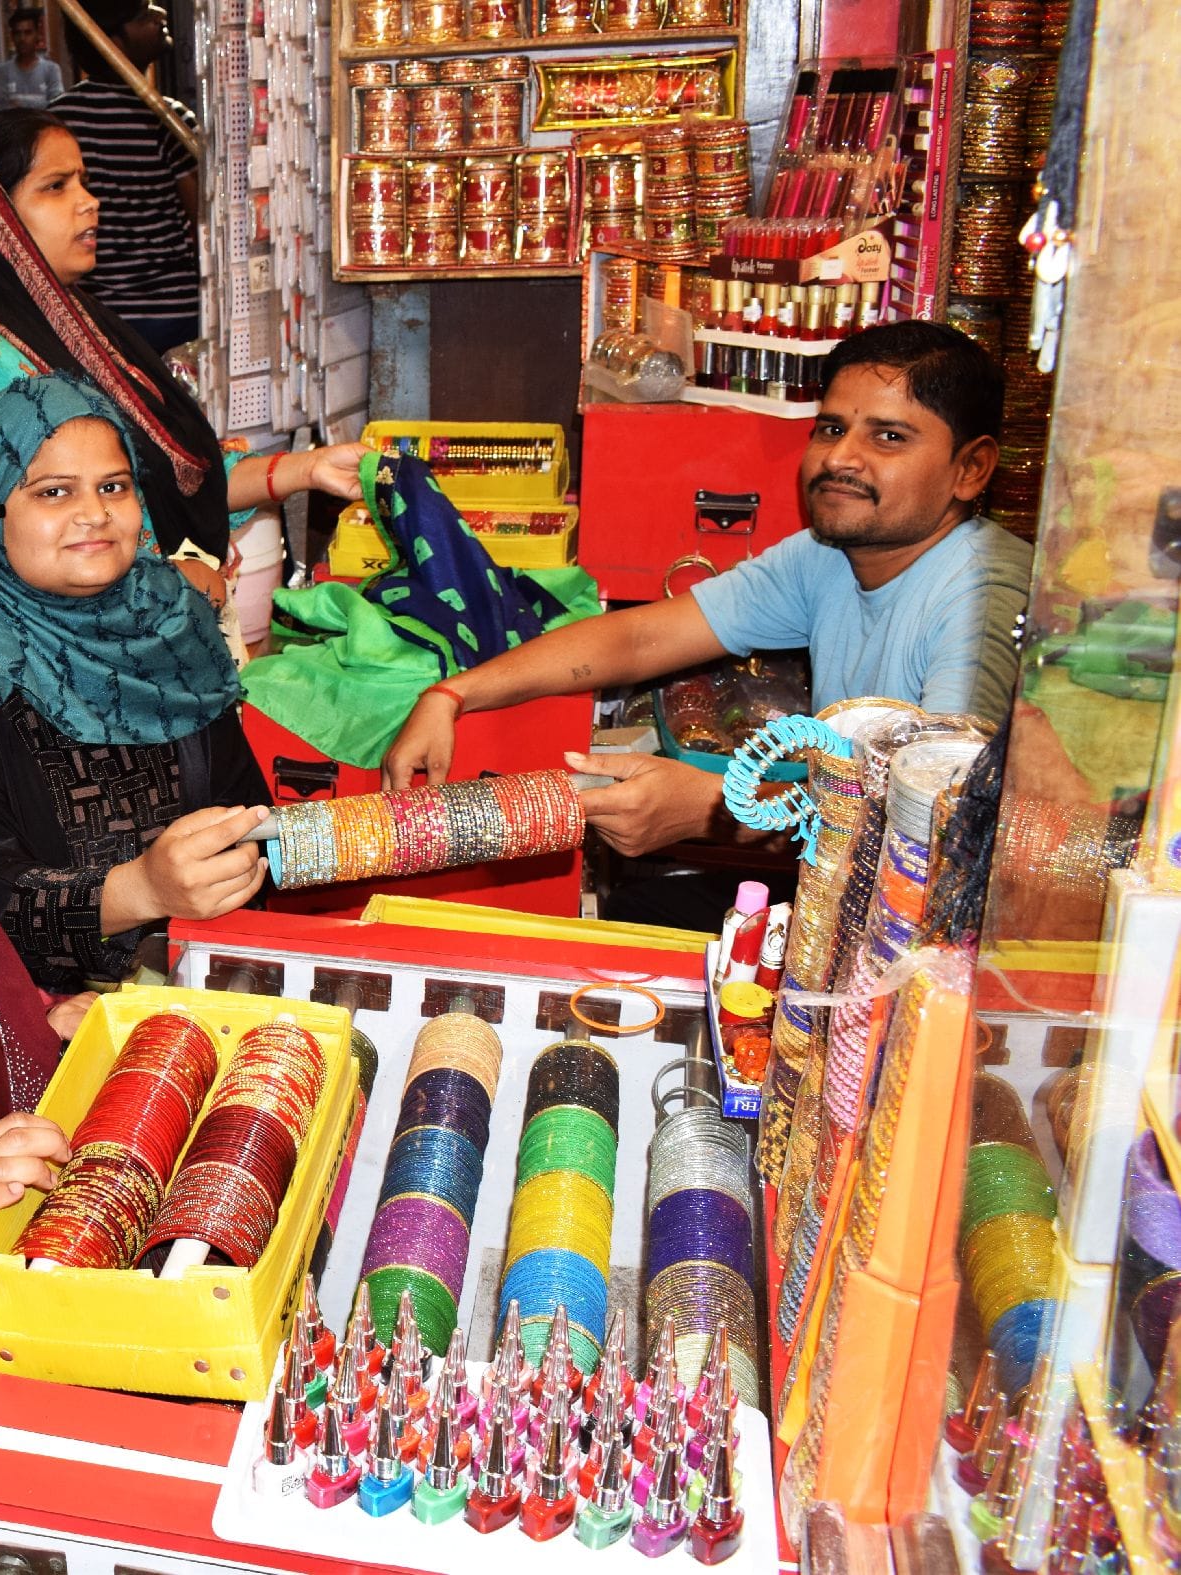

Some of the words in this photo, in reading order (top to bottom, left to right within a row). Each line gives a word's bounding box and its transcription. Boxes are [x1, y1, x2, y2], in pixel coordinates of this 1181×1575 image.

[940, 70, 948, 91] FINISH
[938, 91, 947, 119] NATURAL
[936, 124, 944, 145] PROOF
[931, 174, 940, 200] LASTING
[930, 200, 938, 218] LONG
